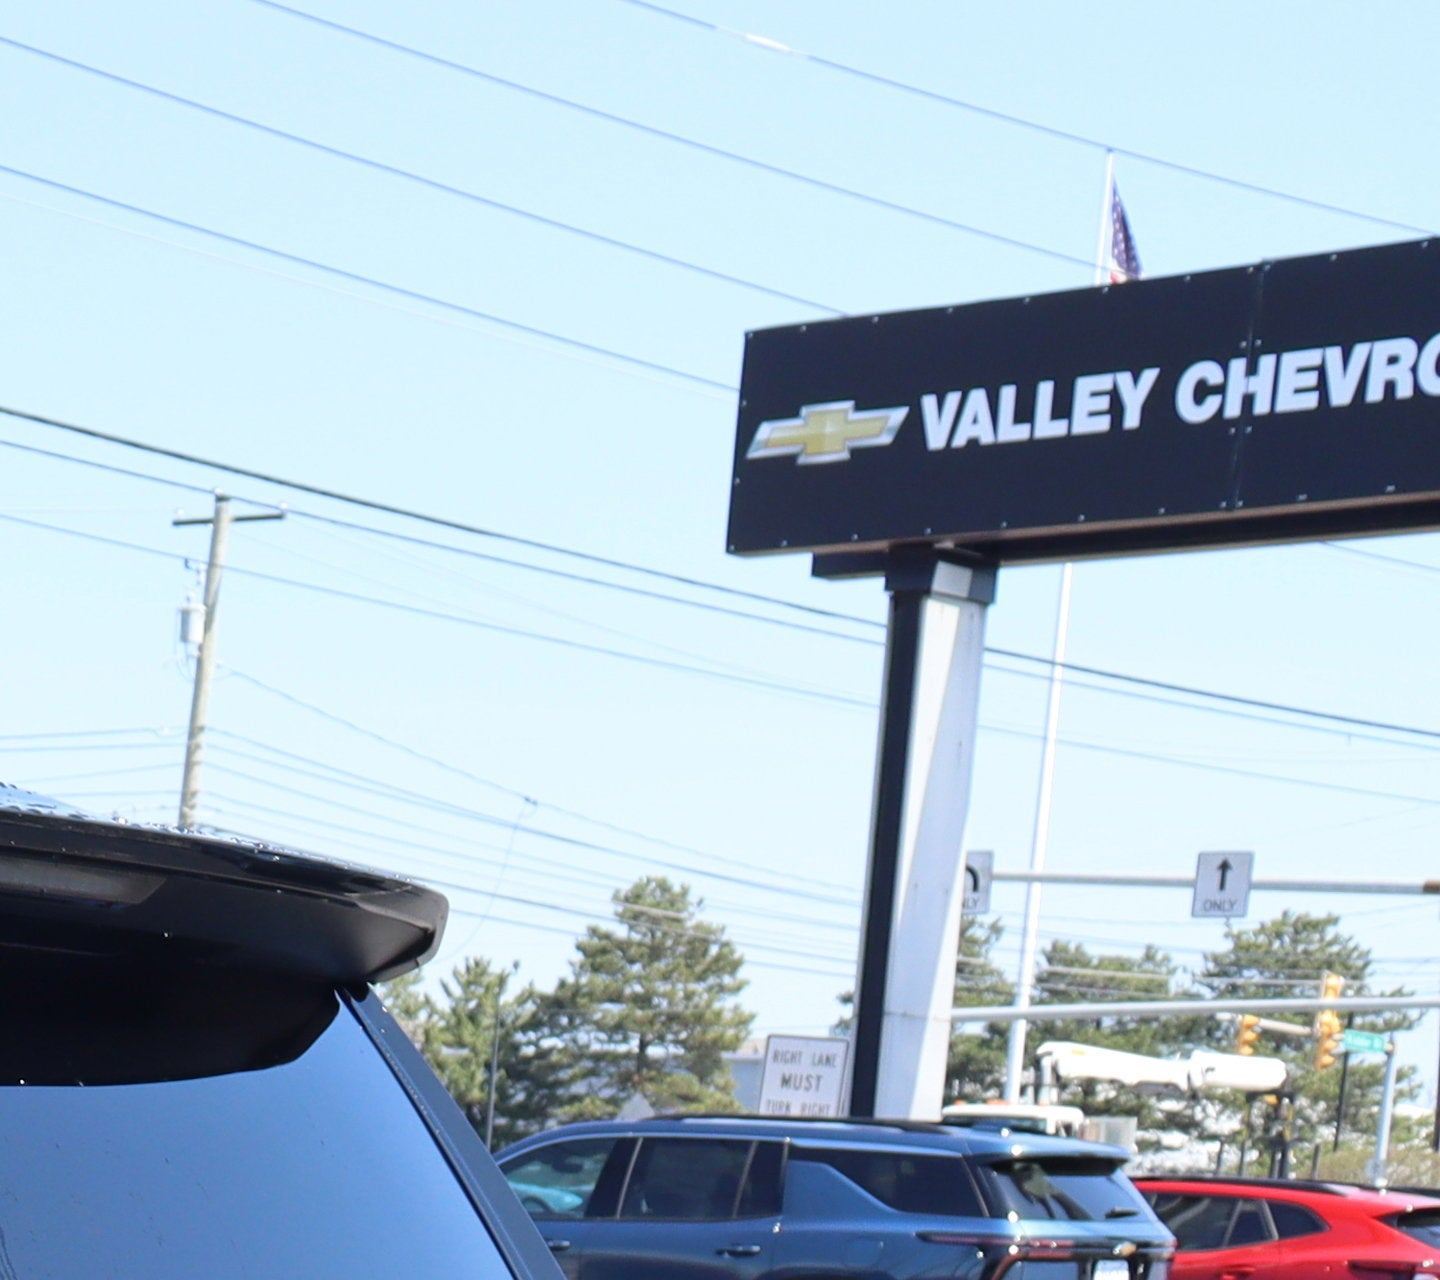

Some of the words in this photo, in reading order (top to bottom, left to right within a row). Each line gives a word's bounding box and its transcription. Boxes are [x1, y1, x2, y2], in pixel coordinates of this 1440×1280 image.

[920, 367, 1161, 451] VALLEY
[1203, 898, 1238, 912] ONLY
[772, 1049, 802, 1065] RIGHT
[811, 1051, 838, 1068] LANE
[780, 1072, 824, 1093] MUST
[767, 1098, 791, 1115] TURN
[800, 1101, 831, 1116] RIGHT
